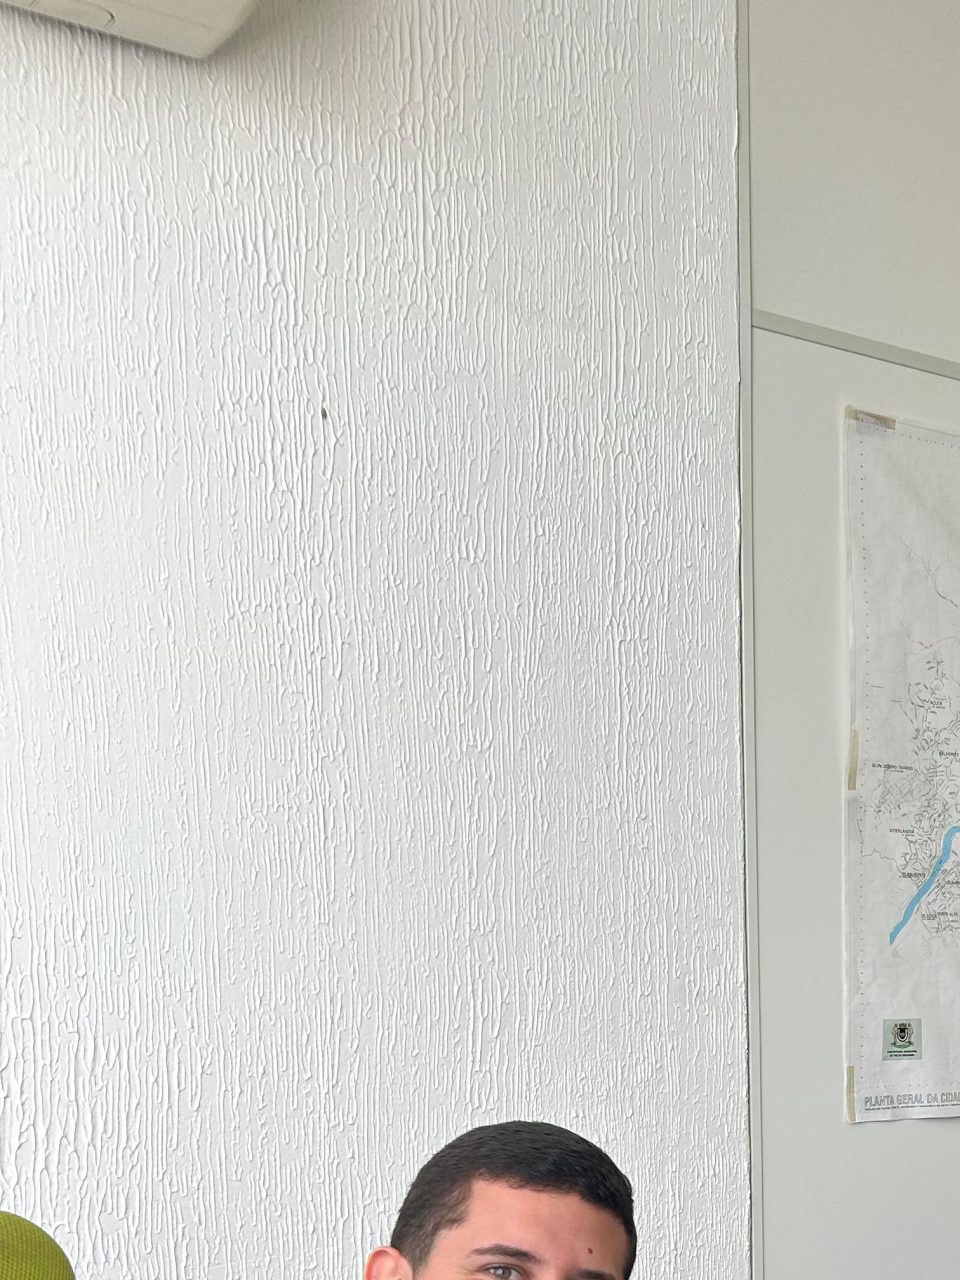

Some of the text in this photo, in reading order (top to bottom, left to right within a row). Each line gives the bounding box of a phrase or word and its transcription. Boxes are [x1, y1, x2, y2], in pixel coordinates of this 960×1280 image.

[864, 1095, 894, 1107] PLANTA
[896, 1093, 924, 1105] GERAL
[927, 1093, 938, 1104] DA
